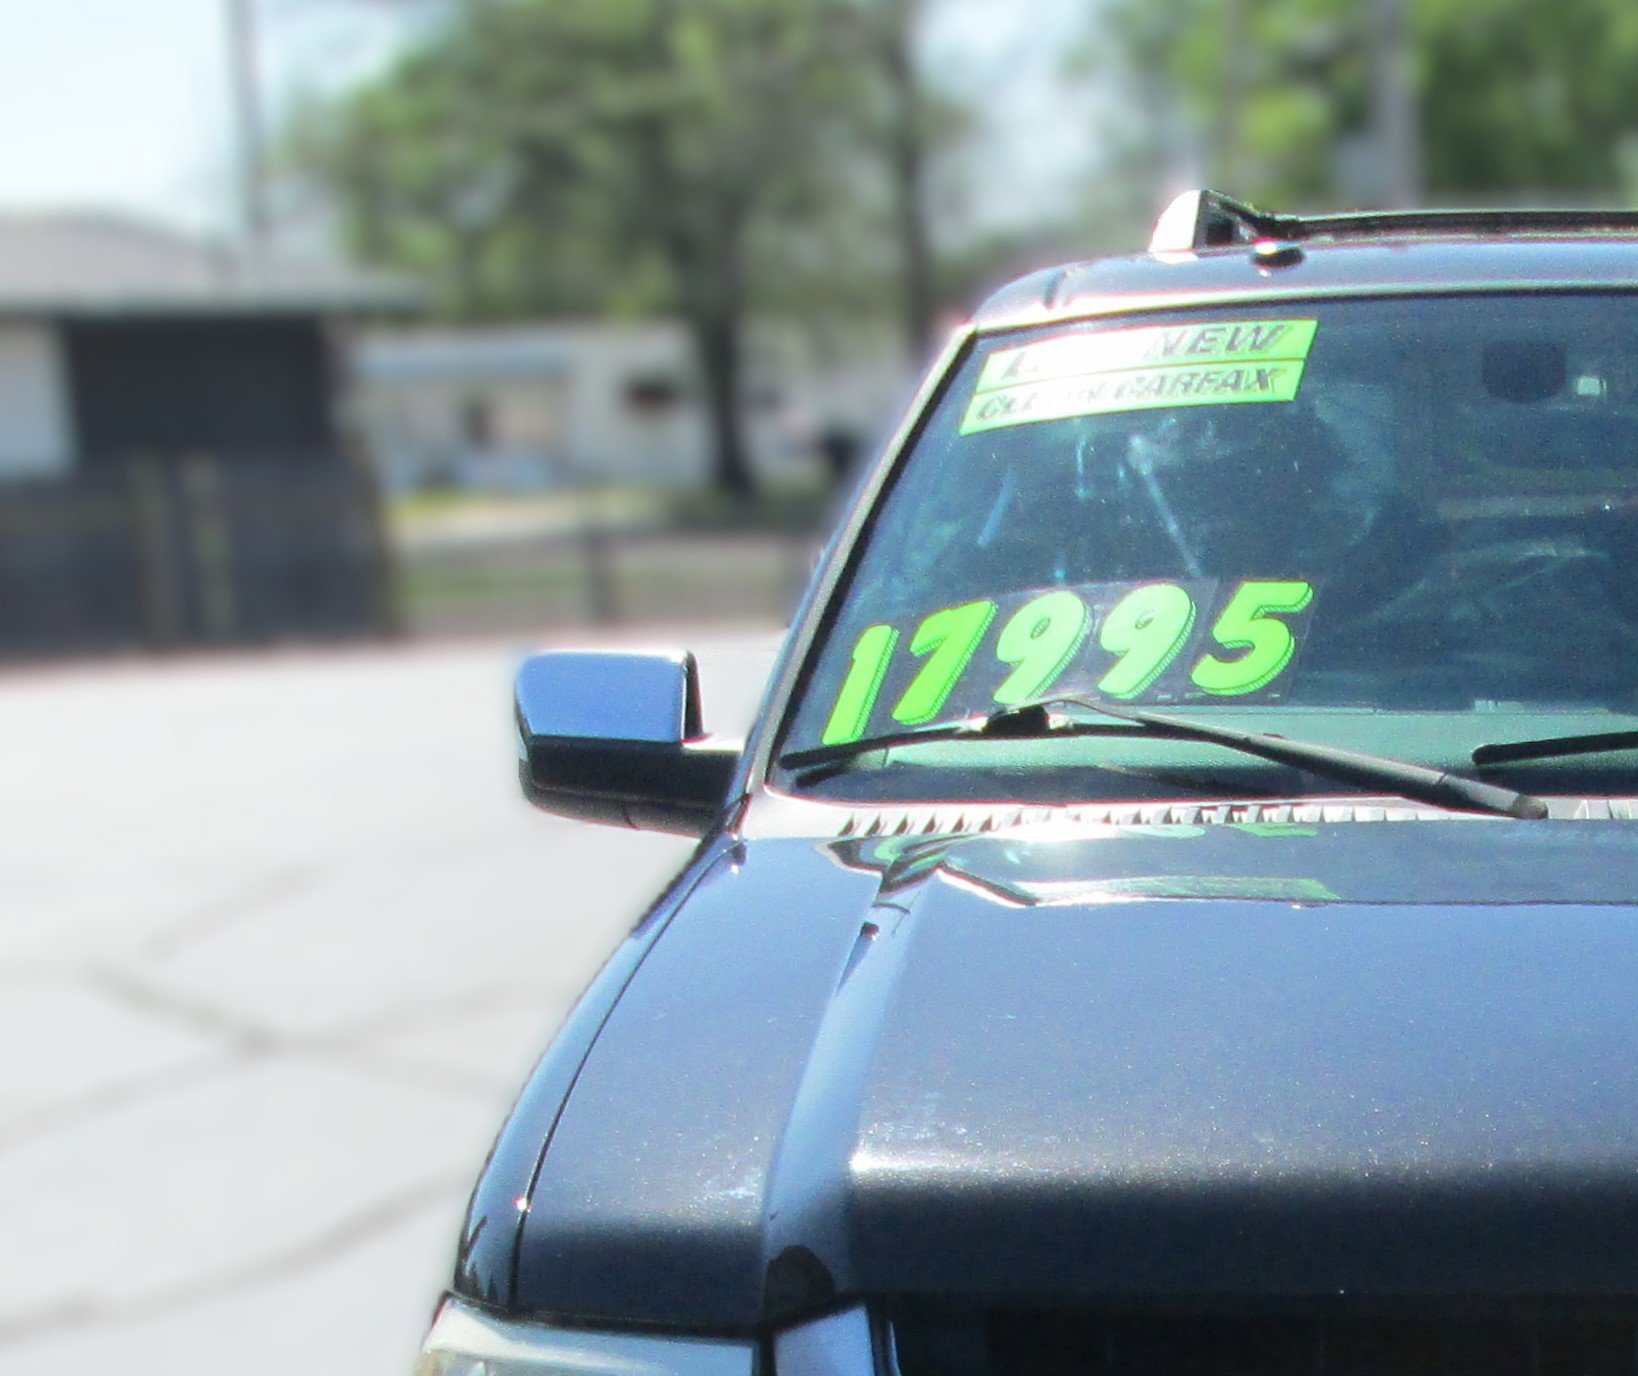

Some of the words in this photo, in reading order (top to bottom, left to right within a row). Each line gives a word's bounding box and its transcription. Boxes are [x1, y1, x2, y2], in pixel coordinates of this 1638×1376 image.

[1144, 324, 1289, 361] NEW
[1113, 367, 1285, 401] CARFAX
[821, 580, 1314, 746] 17995
